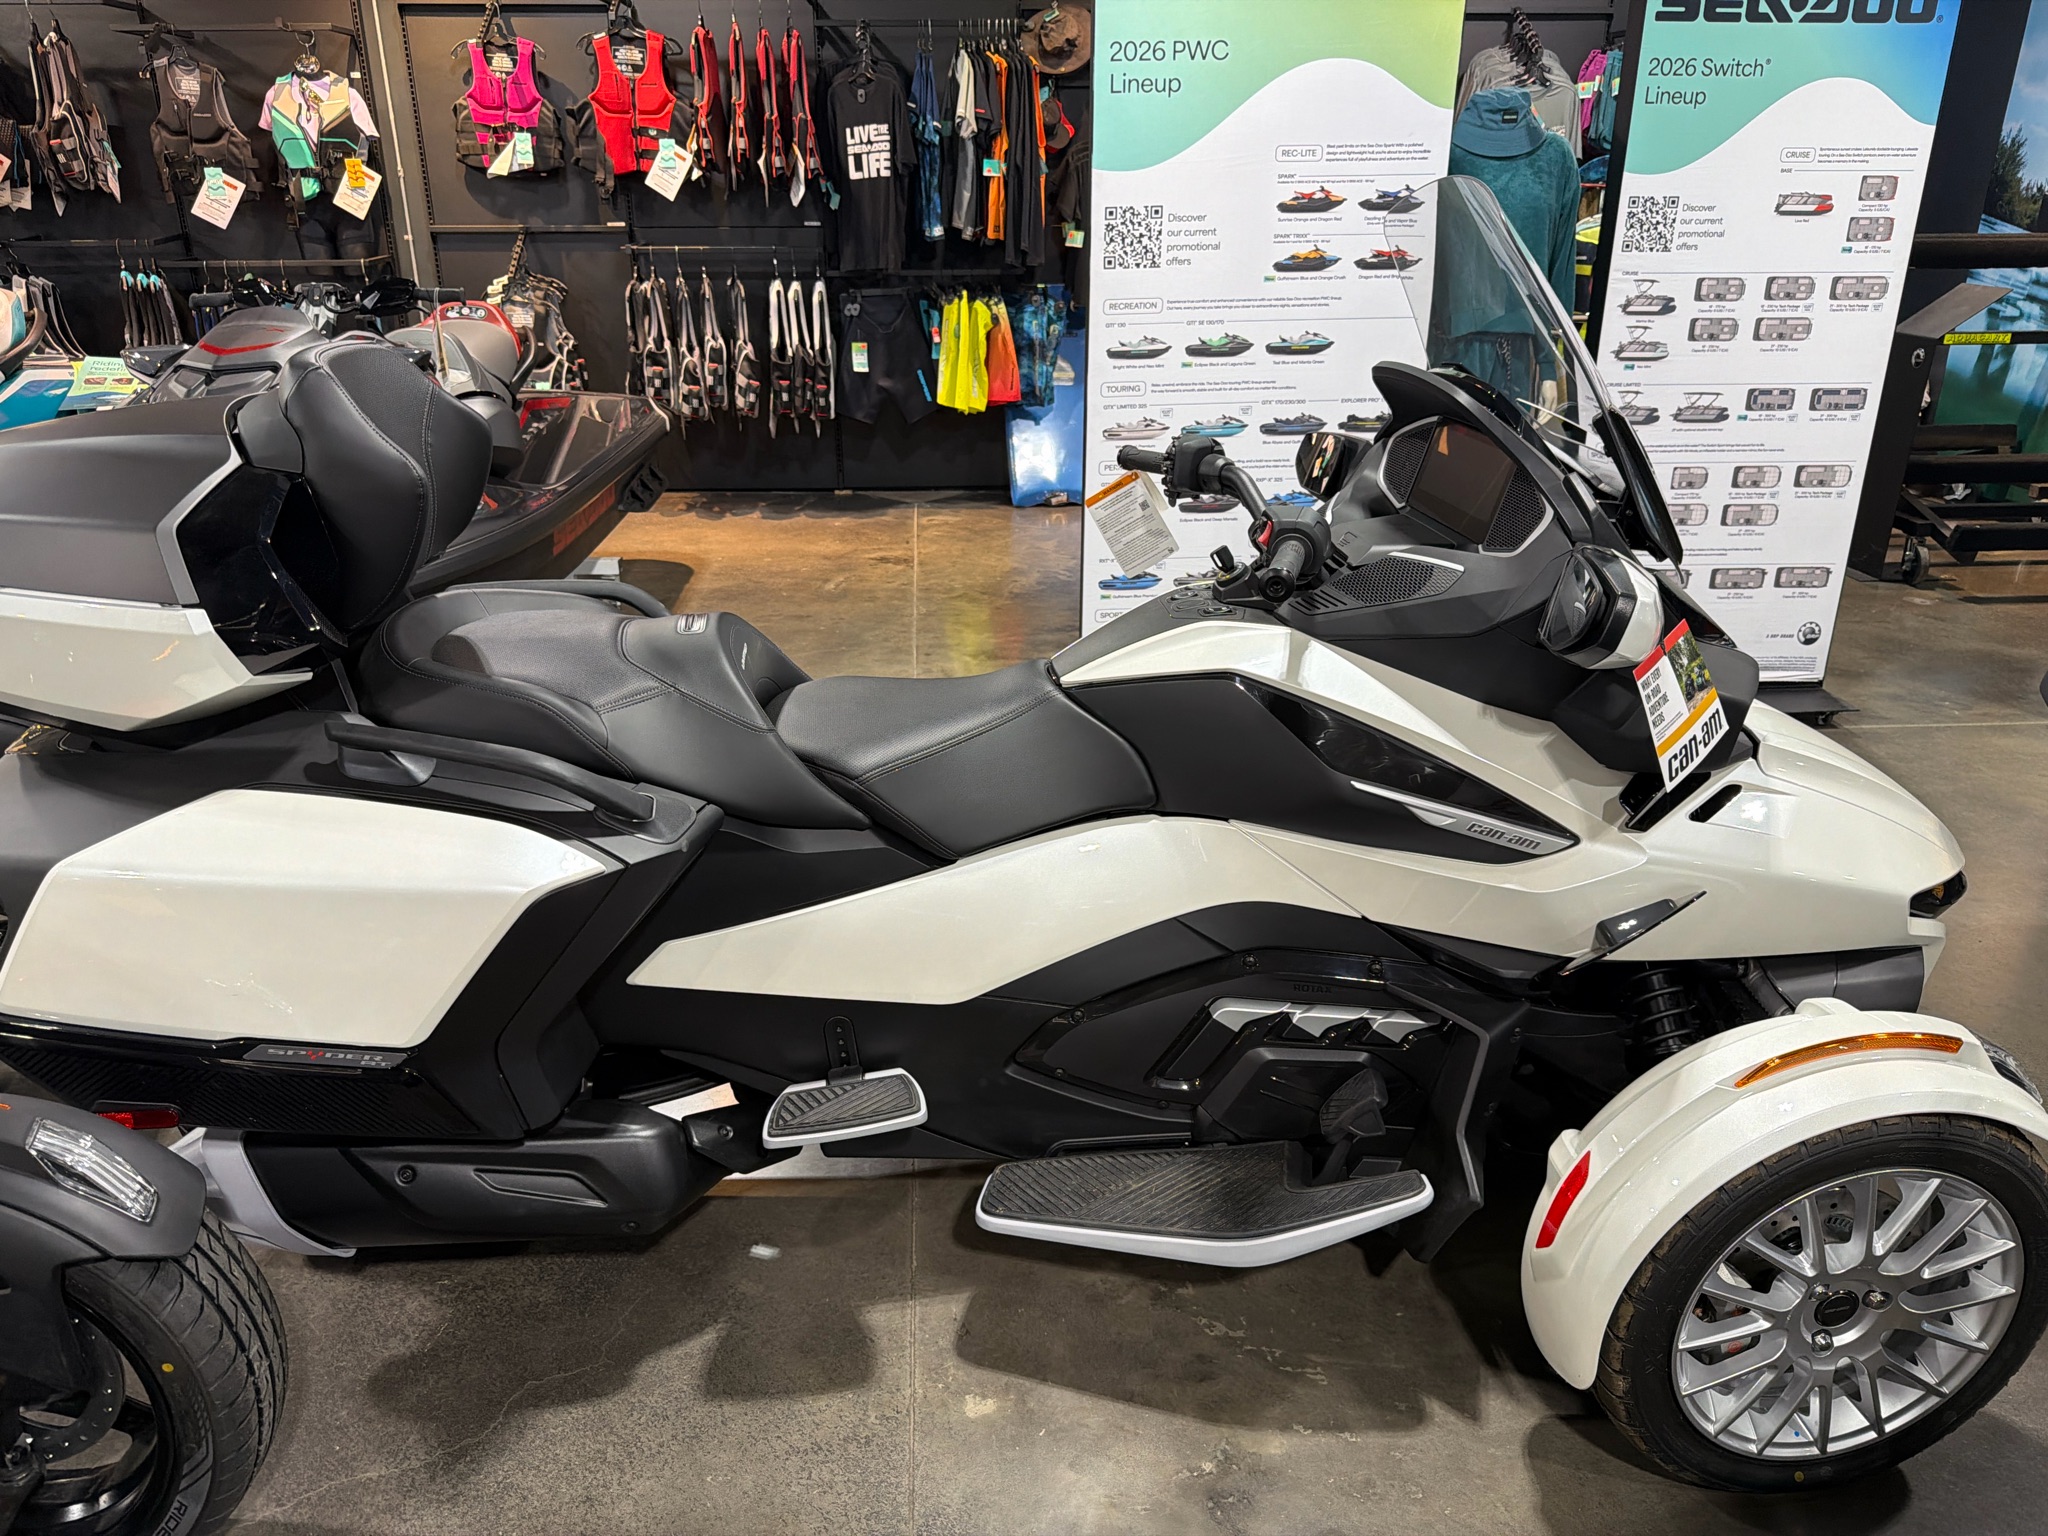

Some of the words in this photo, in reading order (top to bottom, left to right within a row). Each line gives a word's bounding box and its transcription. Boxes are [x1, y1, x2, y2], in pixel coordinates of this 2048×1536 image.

[1109, 40, 1166, 62] 2026
[1172, 40, 1230, 61] PWC
[1648, 58, 1697, 76] 2026
[1110, 73, 1182, 98] Lineup
[1645, 86, 1706, 109] Lineup
[846, 124, 890, 145] LIVE
[1281, 149, 1317, 157] REC-LITE
[848, 152, 891, 180] LIFE
[1682, 203, 1716, 212] Discover
[1168, 213, 1207, 222] Discover
[1184, 228, 1217, 236] current
[1678, 230, 1725, 239] promotional
[1166, 242, 1221, 253] promotional
[1676, 242, 1698, 250] offers
[1166, 257, 1191, 266] offers
[1109, 302, 1158, 310] RECREATION
[1106, 385, 1140, 393] TOURING
[1640, 675, 1652, 691] WHAT
[1651, 666, 1662, 684] EVERY
[1649, 691, 1670, 718] ADVENTURE
[1652, 713, 1666, 730] NEEDS
[1667, 707, 1723, 783] can-am
[1466, 821, 1541, 850] can-am
[1293, 983, 1333, 994] ROTAX
[267, 1048, 384, 1061] SPYDER
